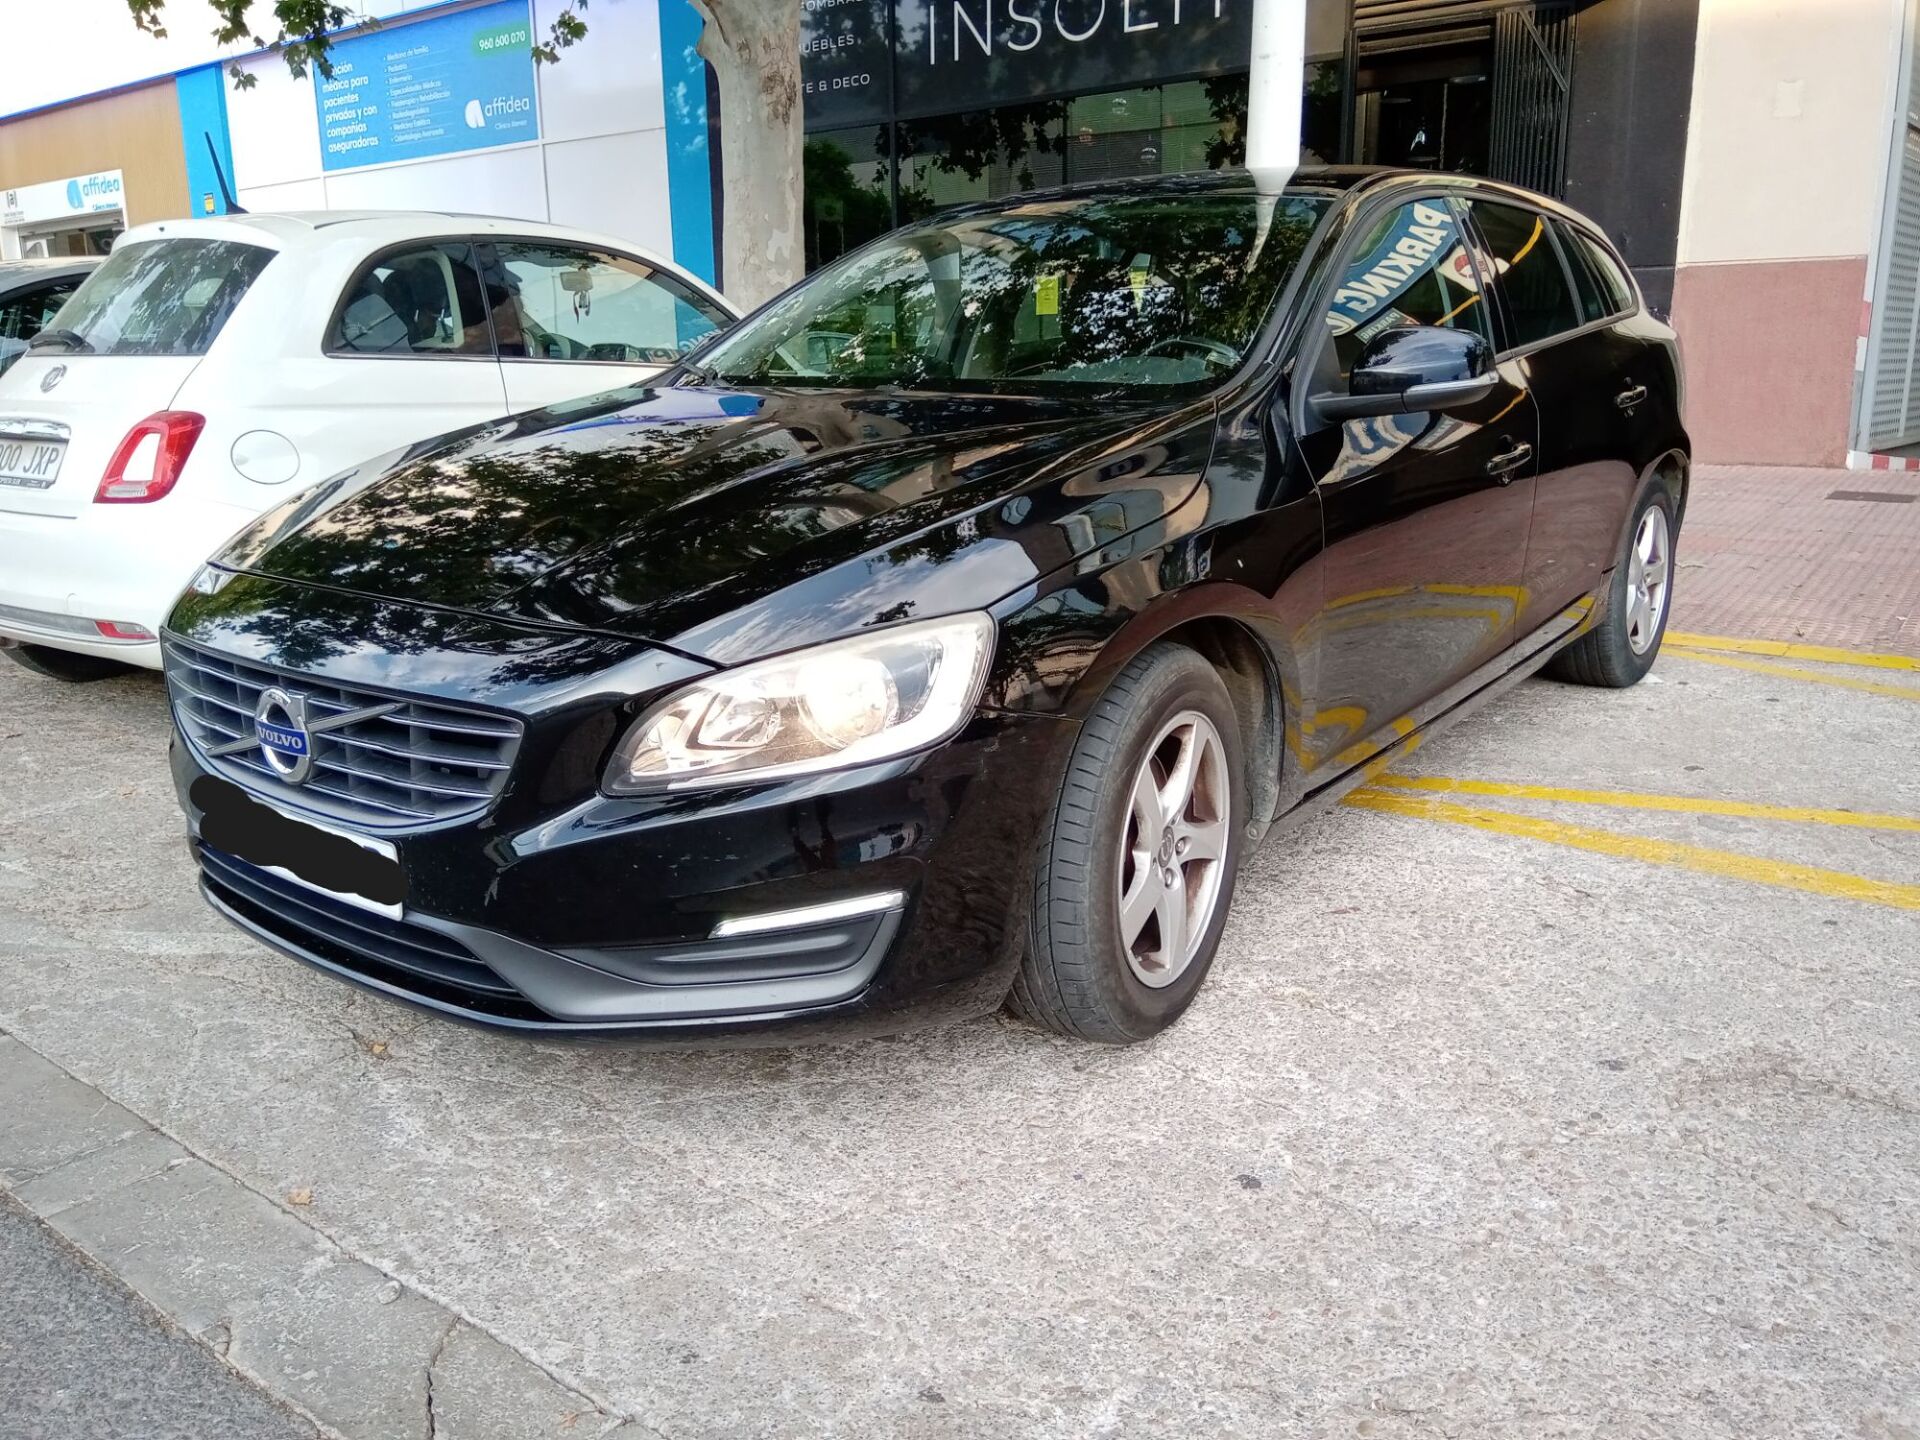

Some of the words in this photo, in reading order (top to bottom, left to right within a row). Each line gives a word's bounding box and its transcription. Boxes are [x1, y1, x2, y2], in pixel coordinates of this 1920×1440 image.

[479, 37, 494, 51] 960
[495, 33, 510, 48] 600
[510, 30, 526, 44] 070
[799, 34, 855, 53] UEBLES
[350, 76, 369, 91] para
[819, 80, 827, 91] &
[832, 73, 870, 89] DECO
[323, 93, 360, 111] pacientes
[484, 95, 530, 117] affidea
[325, 107, 357, 127] privadas
[357, 108, 362, 121] y
[362, 105, 378, 116] con
[328, 135, 379, 154] aseguradoras
[82, 176, 120, 197] affidea
[23, 446, 60, 475] JXP
[258, 726, 303, 750] VOLVO
